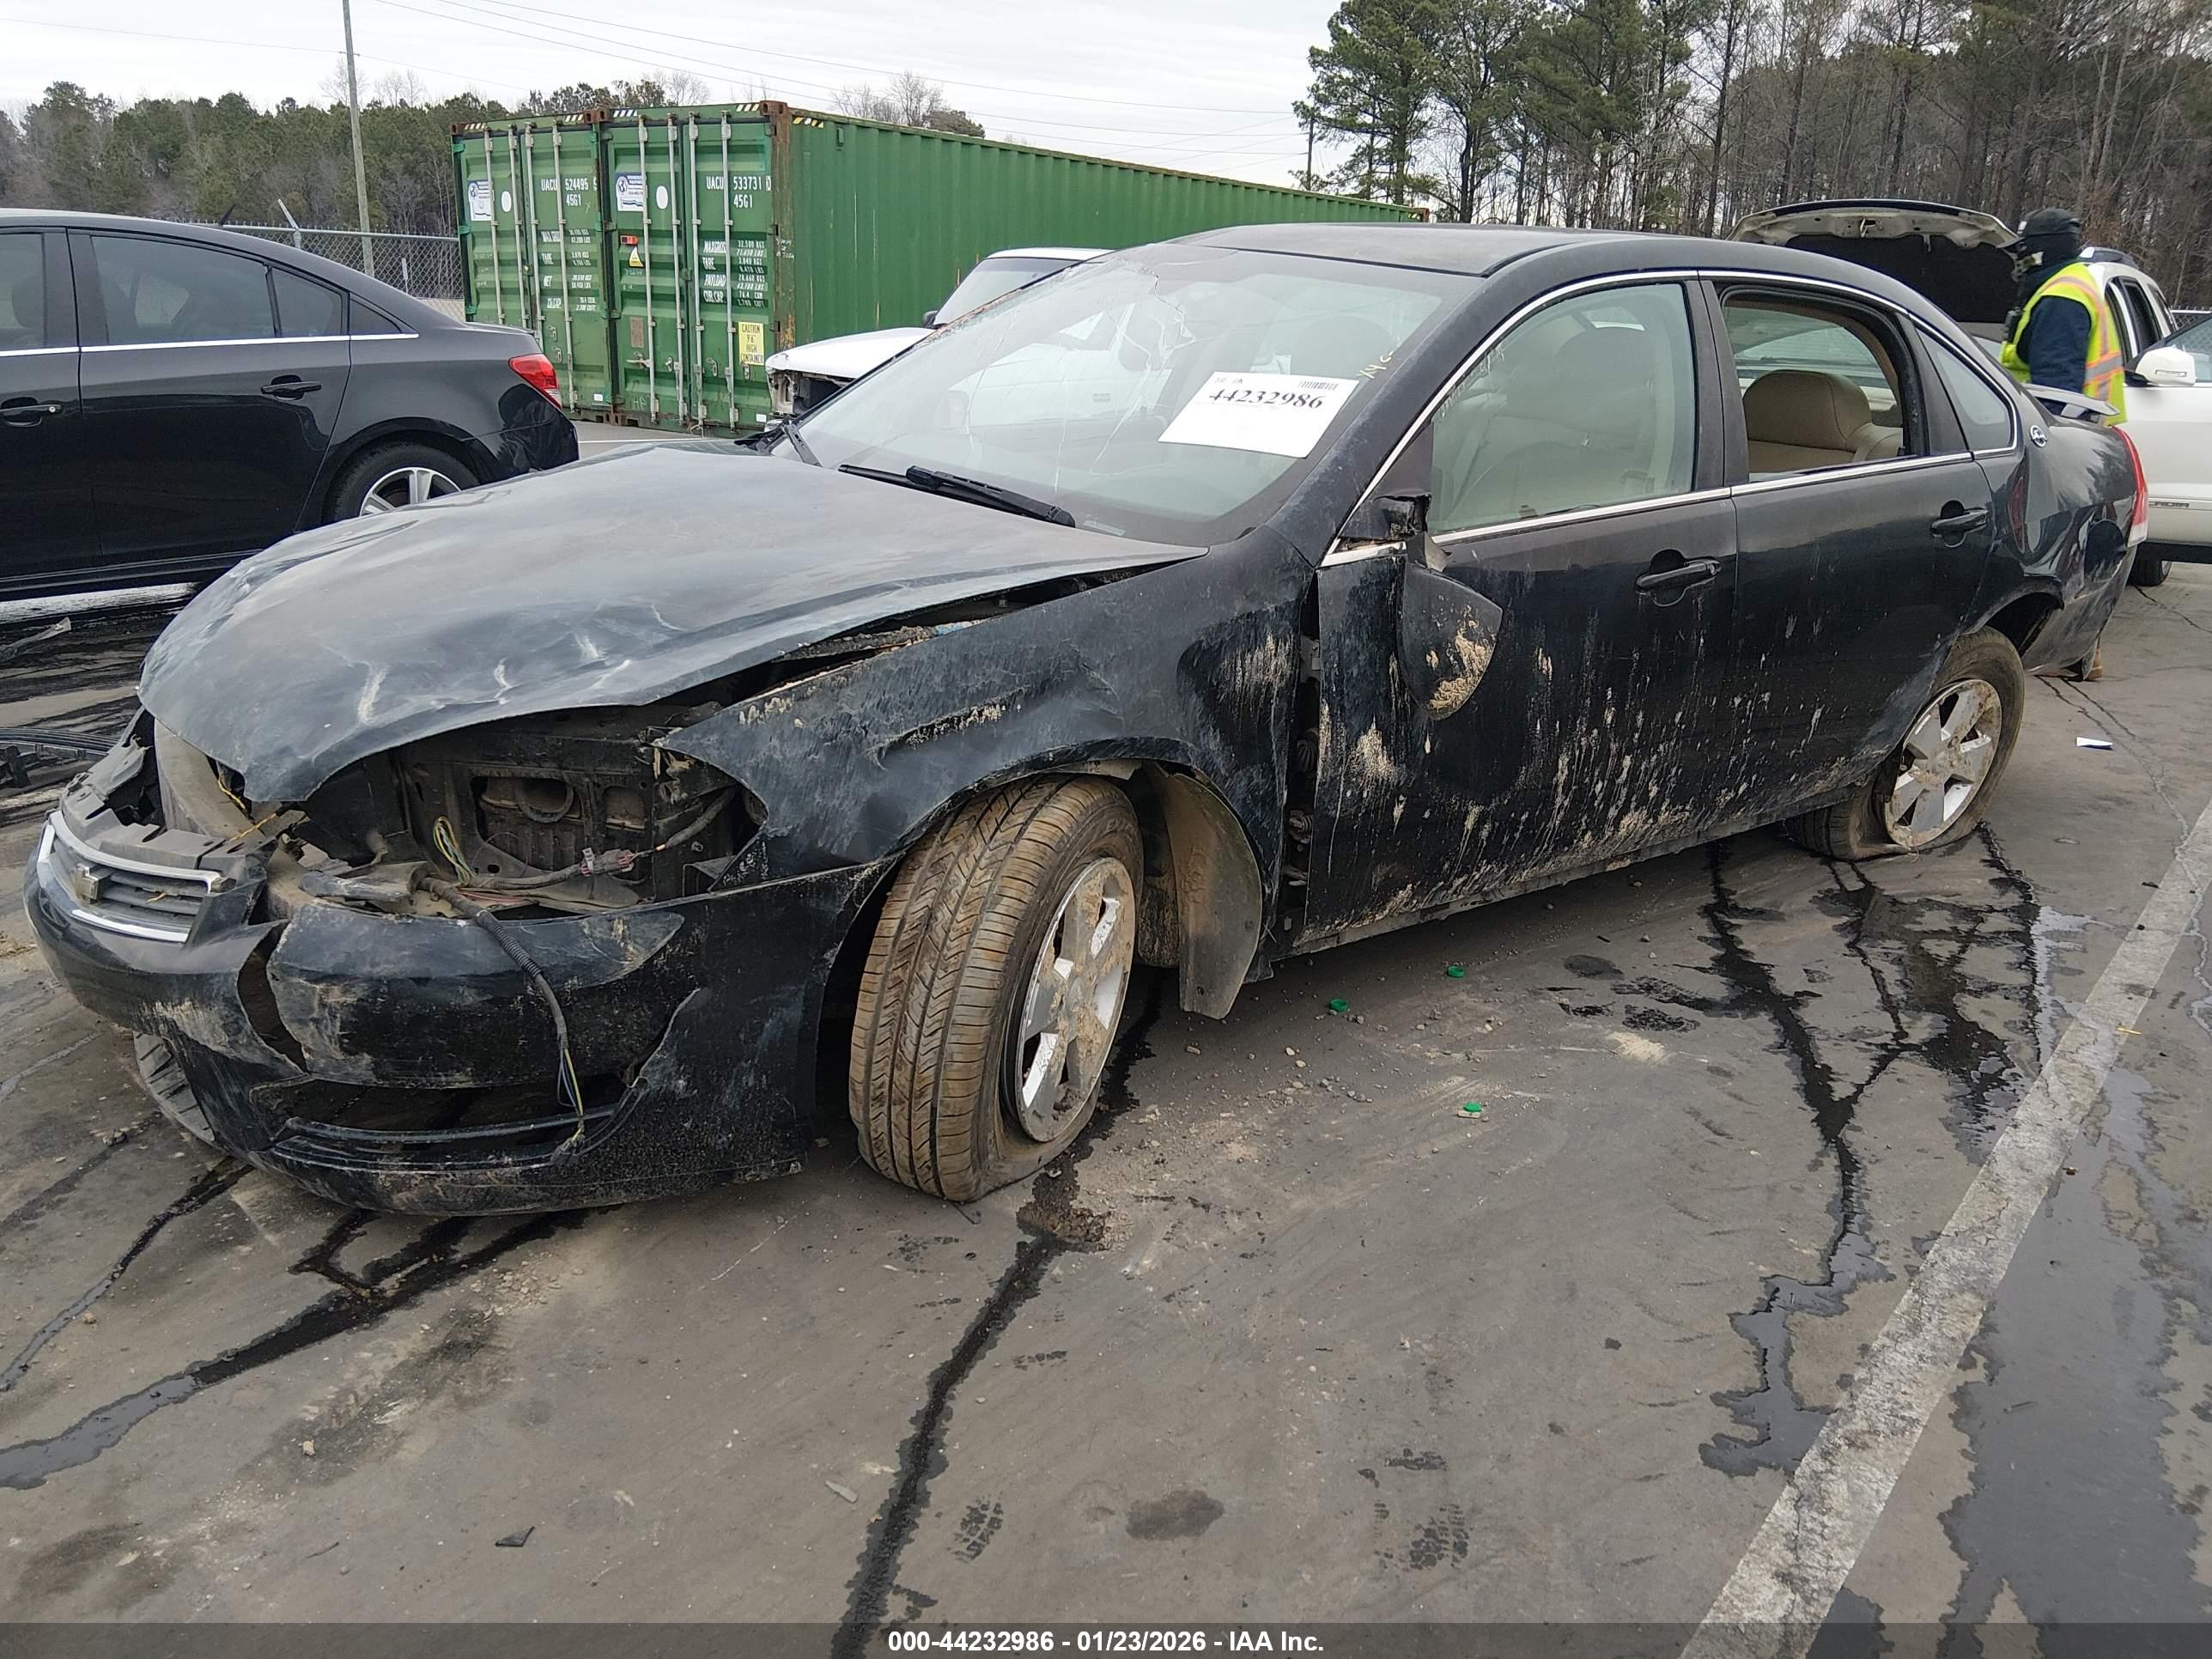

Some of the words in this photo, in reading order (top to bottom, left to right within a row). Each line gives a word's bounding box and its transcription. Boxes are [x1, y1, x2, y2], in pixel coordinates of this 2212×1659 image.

[541, 178, 557, 191] UACU
[564, 177, 589, 191] 524495
[706, 175, 724, 191] UACU
[732, 175, 762, 191] 533731
[565, 193, 581, 207] 45G1
[733, 194, 753, 209] 45G1
[702, 257, 717, 270] TARE
[703, 274, 726, 288] PAYLOAD
[741, 324, 761, 333] CAUTION
[745, 343, 757, 353] HIGH
[740, 353, 763, 364] CONTAINER
[1208, 388, 1327, 410] 44232986
